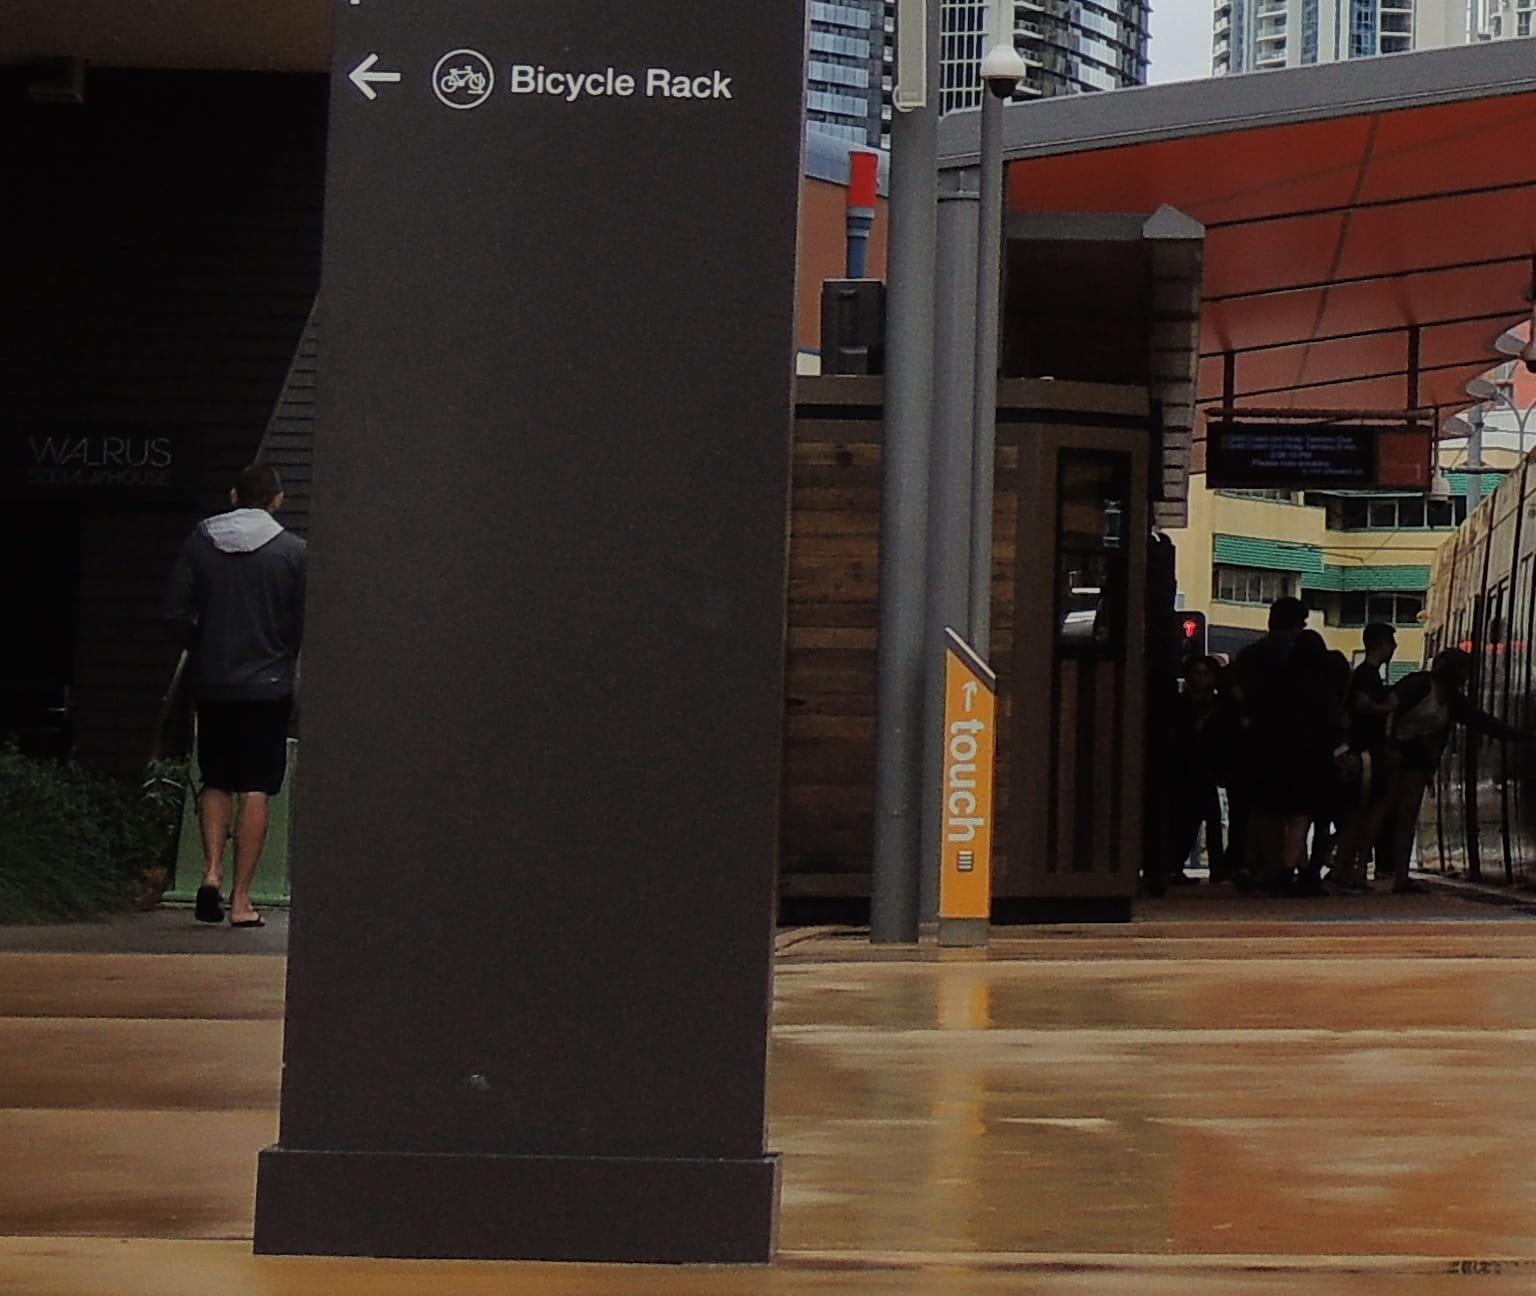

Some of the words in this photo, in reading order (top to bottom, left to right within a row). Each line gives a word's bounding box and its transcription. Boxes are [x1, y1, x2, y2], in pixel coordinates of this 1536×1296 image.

[510, 65, 634, 102] Bicycle
[646, 67, 732, 99] Rack
[29, 436, 172, 467] WALRUS
[947, 718, 985, 843] touch
